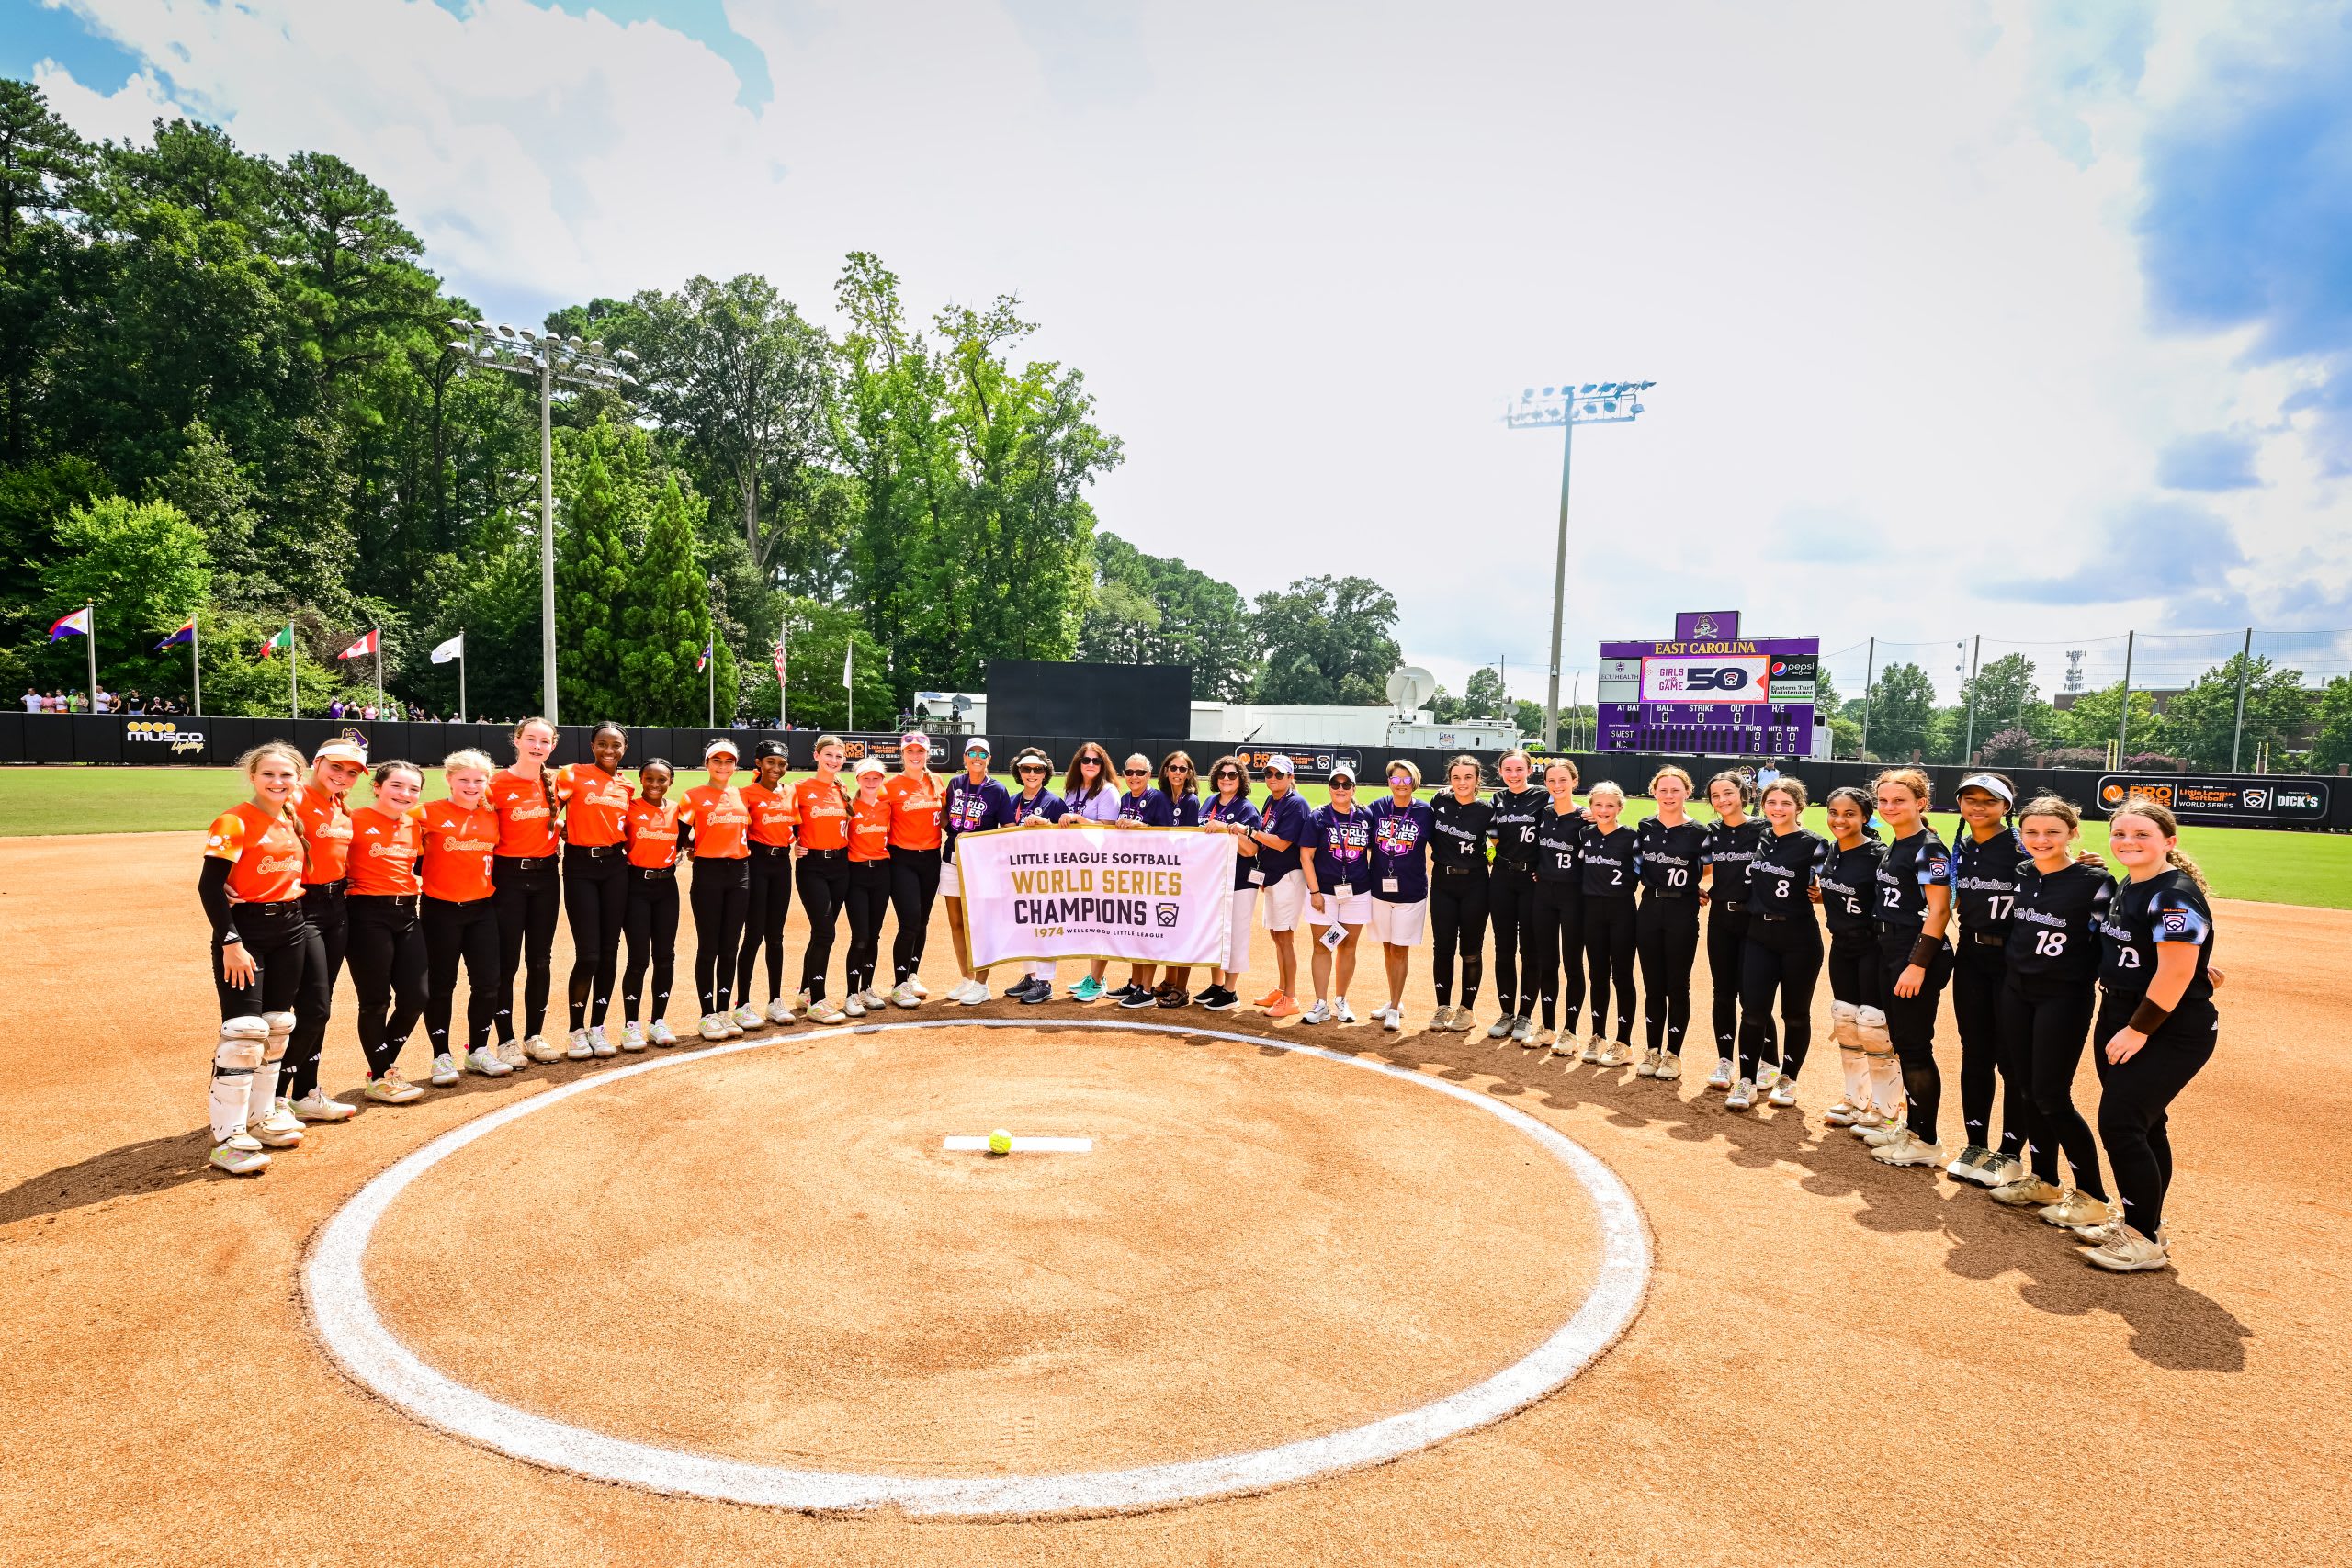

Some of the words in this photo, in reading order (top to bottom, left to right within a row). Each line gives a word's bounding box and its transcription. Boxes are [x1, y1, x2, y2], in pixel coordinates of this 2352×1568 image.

[1654, 643, 1687, 654] EAST
[1689, 642, 1756, 654] CAROLINA
[1660, 668, 1684, 677] GIRLS
[1788, 662, 1815, 671] pepsi
[1685, 667, 1748, 690] 50
[1659, 682, 1683, 690] GAME
[1662, 712, 1669, 723] 0
[1697, 712, 1704, 723] 0
[1734, 712, 1741, 724] 0
[2130, 786, 2172, 799] PRO
[2277, 795, 2318, 807] DICK'S
[1507, 813, 1536, 823] Carolina
[1448, 826, 1476, 840] Carolina
[1519, 825, 1536, 843] 16
[1459, 841, 1475, 854] 14
[1546, 838, 1573, 851] Carolina
[1010, 854, 1050, 866] LITTLE
[1054, 853, 1108, 864] LEAGUE
[1112, 853, 1181, 866] SOFTBALL
[1555, 853, 1572, 869] 13
[1596, 855, 1621, 866] Carolina
[1655, 852, 1689, 866] Carolina
[1760, 861, 1795, 878] Carolina
[1011, 869, 1100, 894] WORLD
[1102, 870, 1182, 896] SERIES
[1611, 869, 1622, 885] 2
[1667, 868, 1687, 887] 10
[1971, 877, 2013, 891] Carolina
[1775, 880, 1790, 898] 8
[1825, 879, 1855, 895] Carolina
[1882, 887, 1901, 908] 12
[1014, 898, 1147, 926] CHAMPIONS
[1988, 895, 2014, 920] 17
[2025, 908, 2067, 927] Carolina
[1034, 926, 1064, 938] 1974
[2035, 931, 2067, 957] 18
